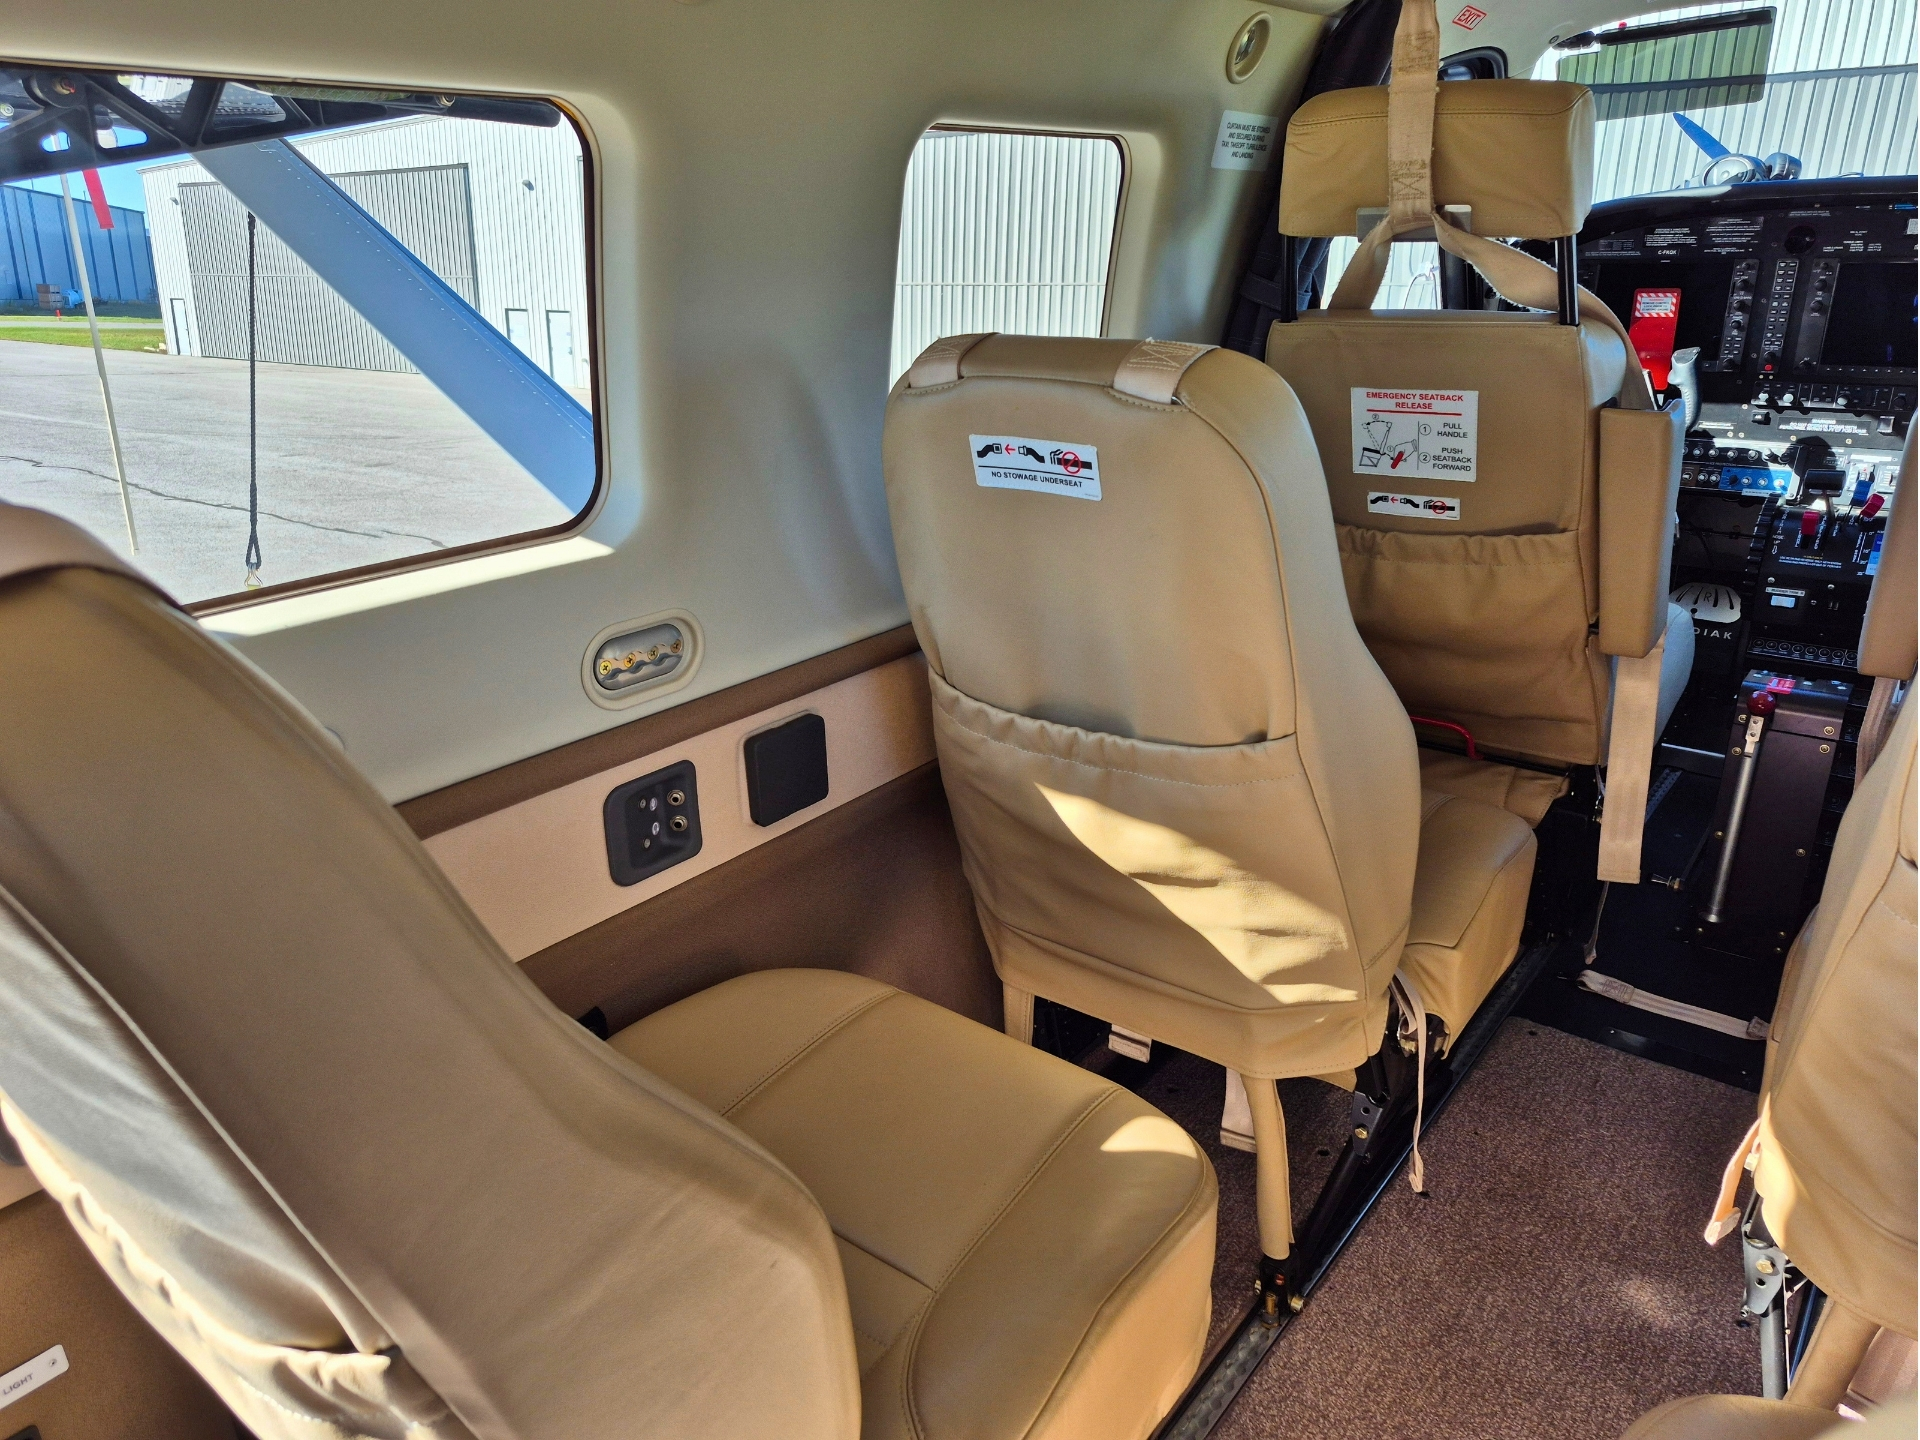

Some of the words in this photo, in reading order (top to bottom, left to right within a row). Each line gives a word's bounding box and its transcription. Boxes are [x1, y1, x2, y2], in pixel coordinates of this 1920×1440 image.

[1456, 8, 1482, 26] EXIT
[1227, 122, 1241, 130] CURTAIN
[1241, 124, 1251, 132] MUST
[1256, 126, 1271, 134] STOWED
[1235, 133, 1252, 141] SECURED
[1251, 134, 1265, 142] DURING
[1246, 143, 1268, 152] TURBULENCE
[1366, 391, 1417, 400] EMERGENCY
[1418, 393, 1464, 402] SEATBACK
[1395, 401, 1433, 410] RELEASE
[1443, 422, 1462, 430] PULL
[1437, 430, 1468, 439] HANDLE
[1441, 447, 1463, 455] PUSH
[1432, 455, 1473, 464] SEATBACK
[1432, 463, 1472, 472] FORWARD
[1003, 472, 1038, 482] STOWAGE
[1039, 476, 1083, 488] UNDERSEAT
[1693, 627, 1732, 640] DIAK
[2, 1372, 34, 1395] LIGHT
